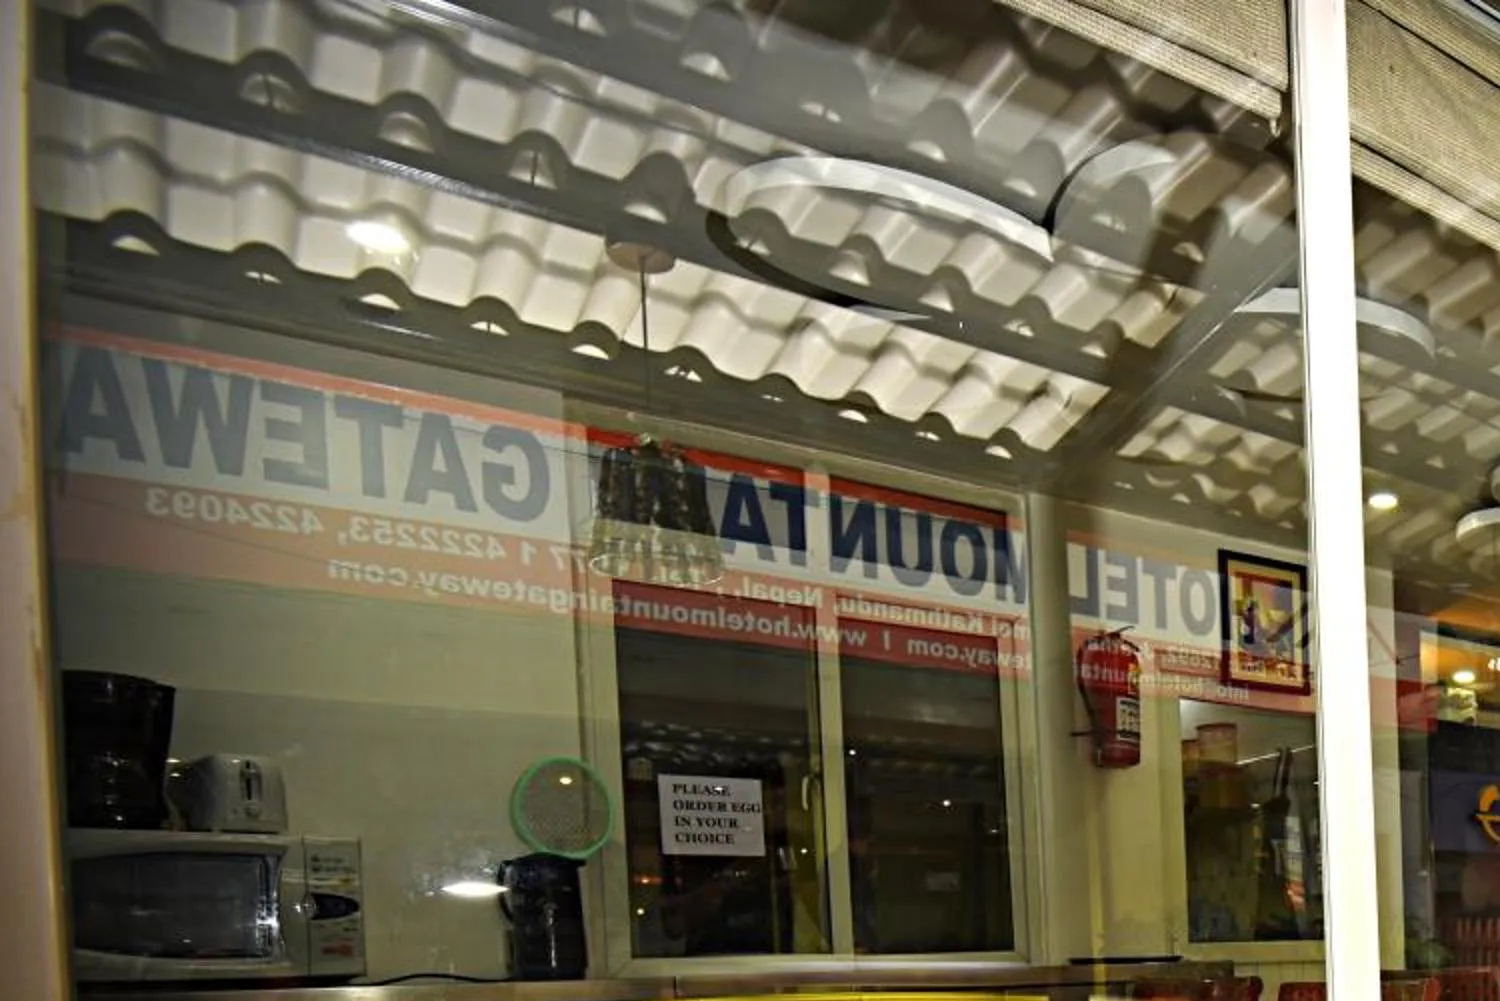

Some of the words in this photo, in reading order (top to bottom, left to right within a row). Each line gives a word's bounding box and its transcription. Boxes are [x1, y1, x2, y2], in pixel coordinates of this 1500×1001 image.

[672, 783, 731, 797] PLEASE
[673, 800, 728, 813] ORDER
[674, 816, 691, 827] IN
[695, 818, 739, 830] YOUR
[674, 832, 735, 846] CHOICE
